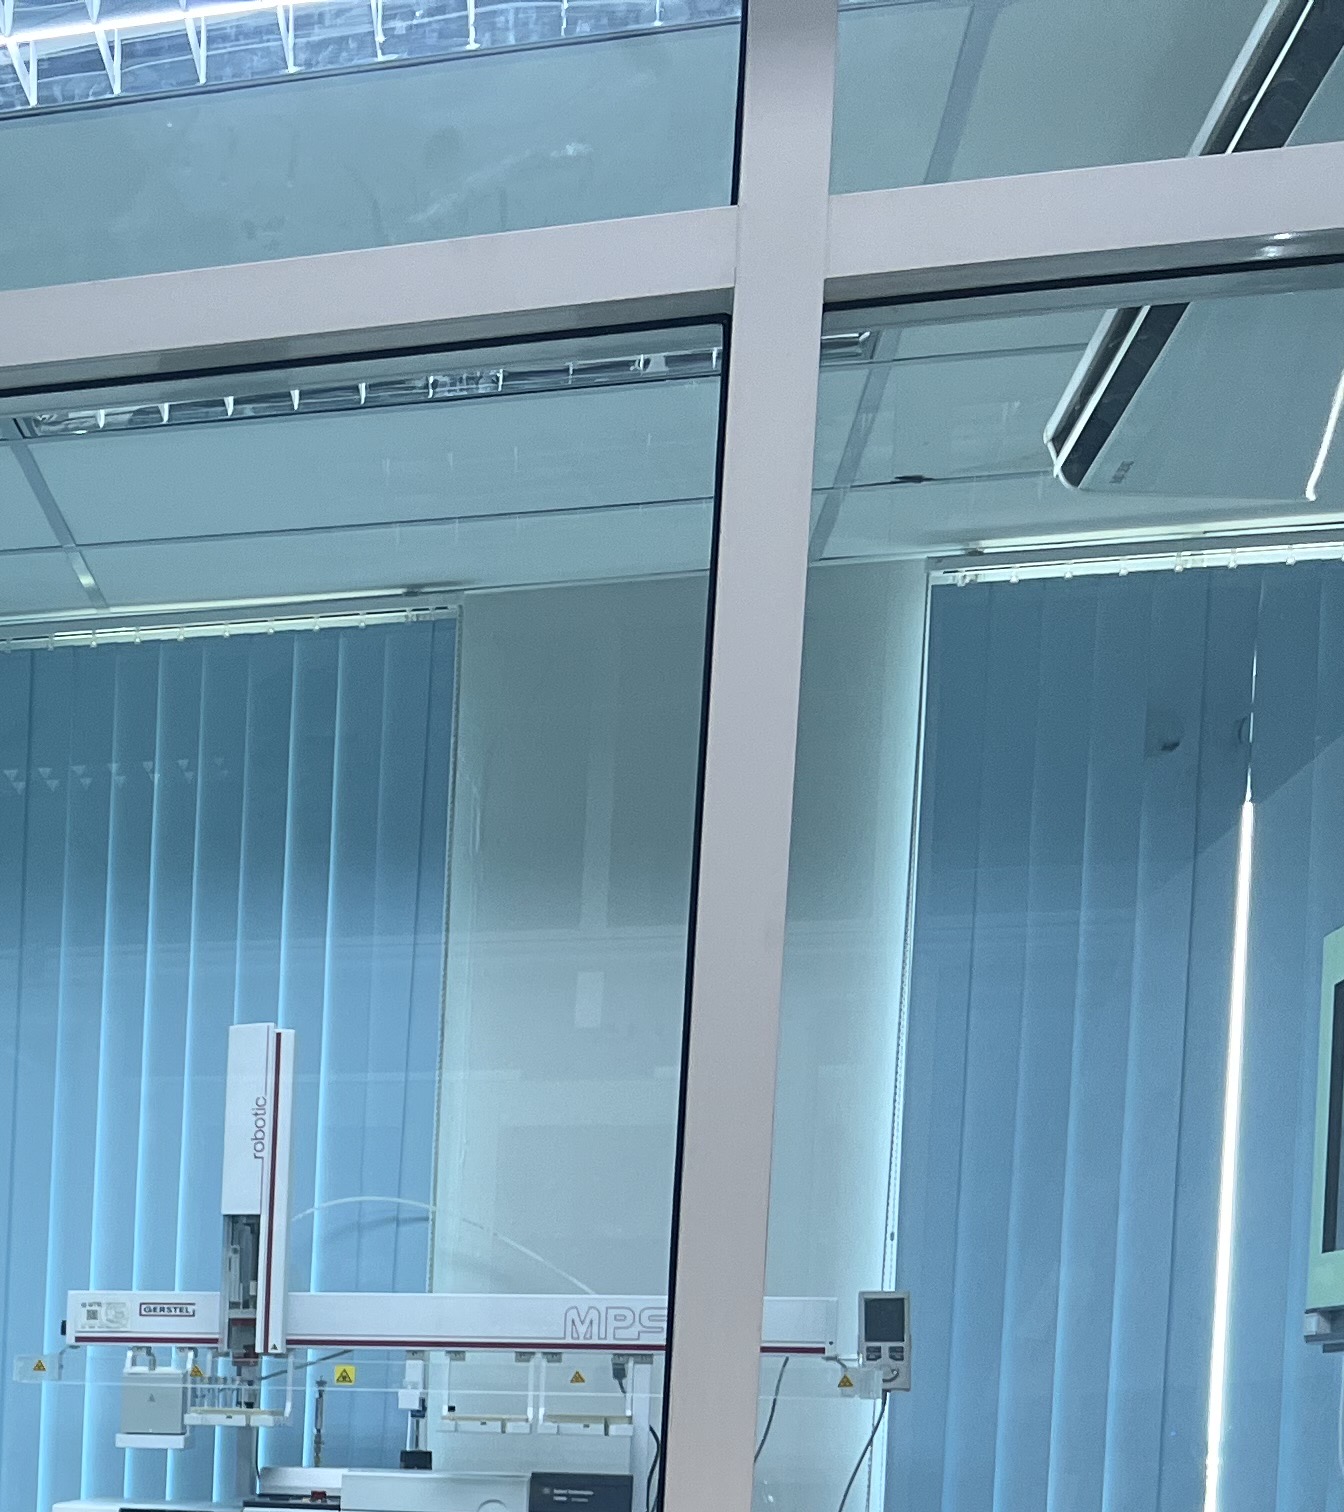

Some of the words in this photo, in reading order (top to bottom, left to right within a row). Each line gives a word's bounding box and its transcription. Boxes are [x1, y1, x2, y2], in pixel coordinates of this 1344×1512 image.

[251, 1096, 267, 1159] robotic
[143, 1305, 191, 1314] GERSTEL
[563, 1305, 668, 1340] MPS
